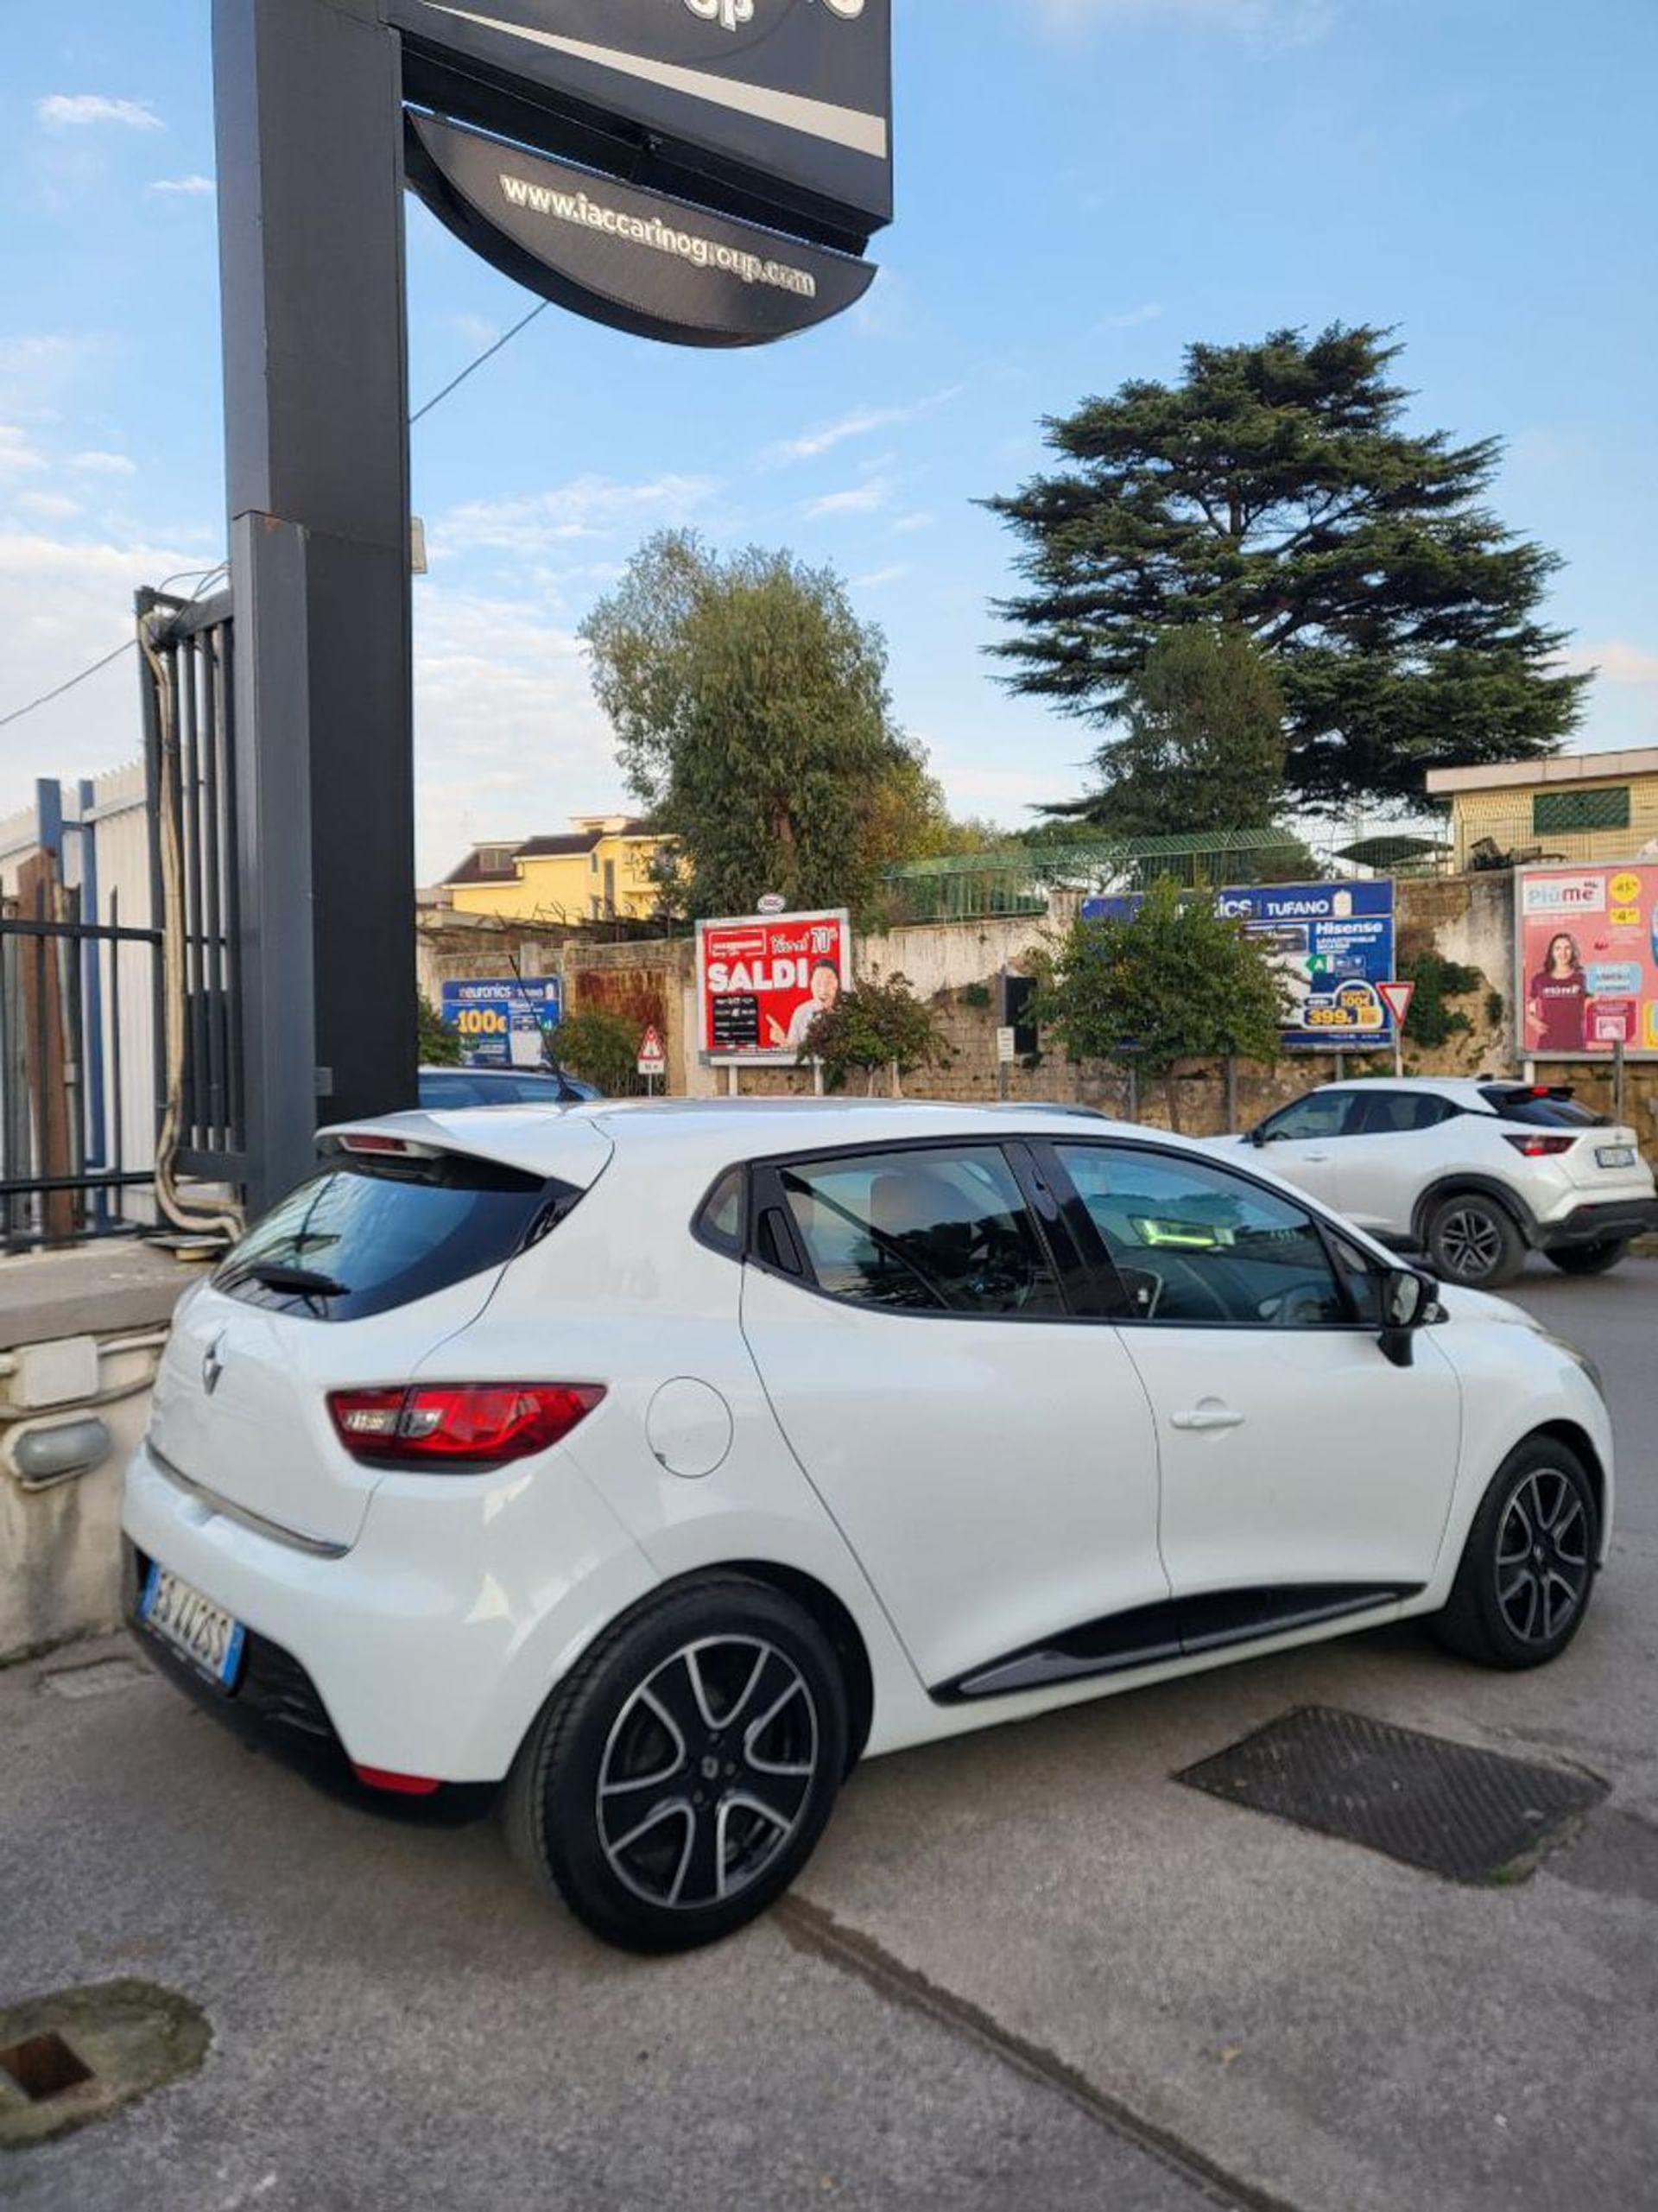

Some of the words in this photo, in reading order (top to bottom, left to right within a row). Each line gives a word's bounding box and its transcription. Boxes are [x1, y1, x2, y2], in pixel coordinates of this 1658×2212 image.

[498, 174, 816, 298] www.iaccarinogroup.com
[1266, 898, 1330, 917] TUFANO
[1315, 922, 1383, 935] Hisense
[707, 957, 808, 992] SALDI
